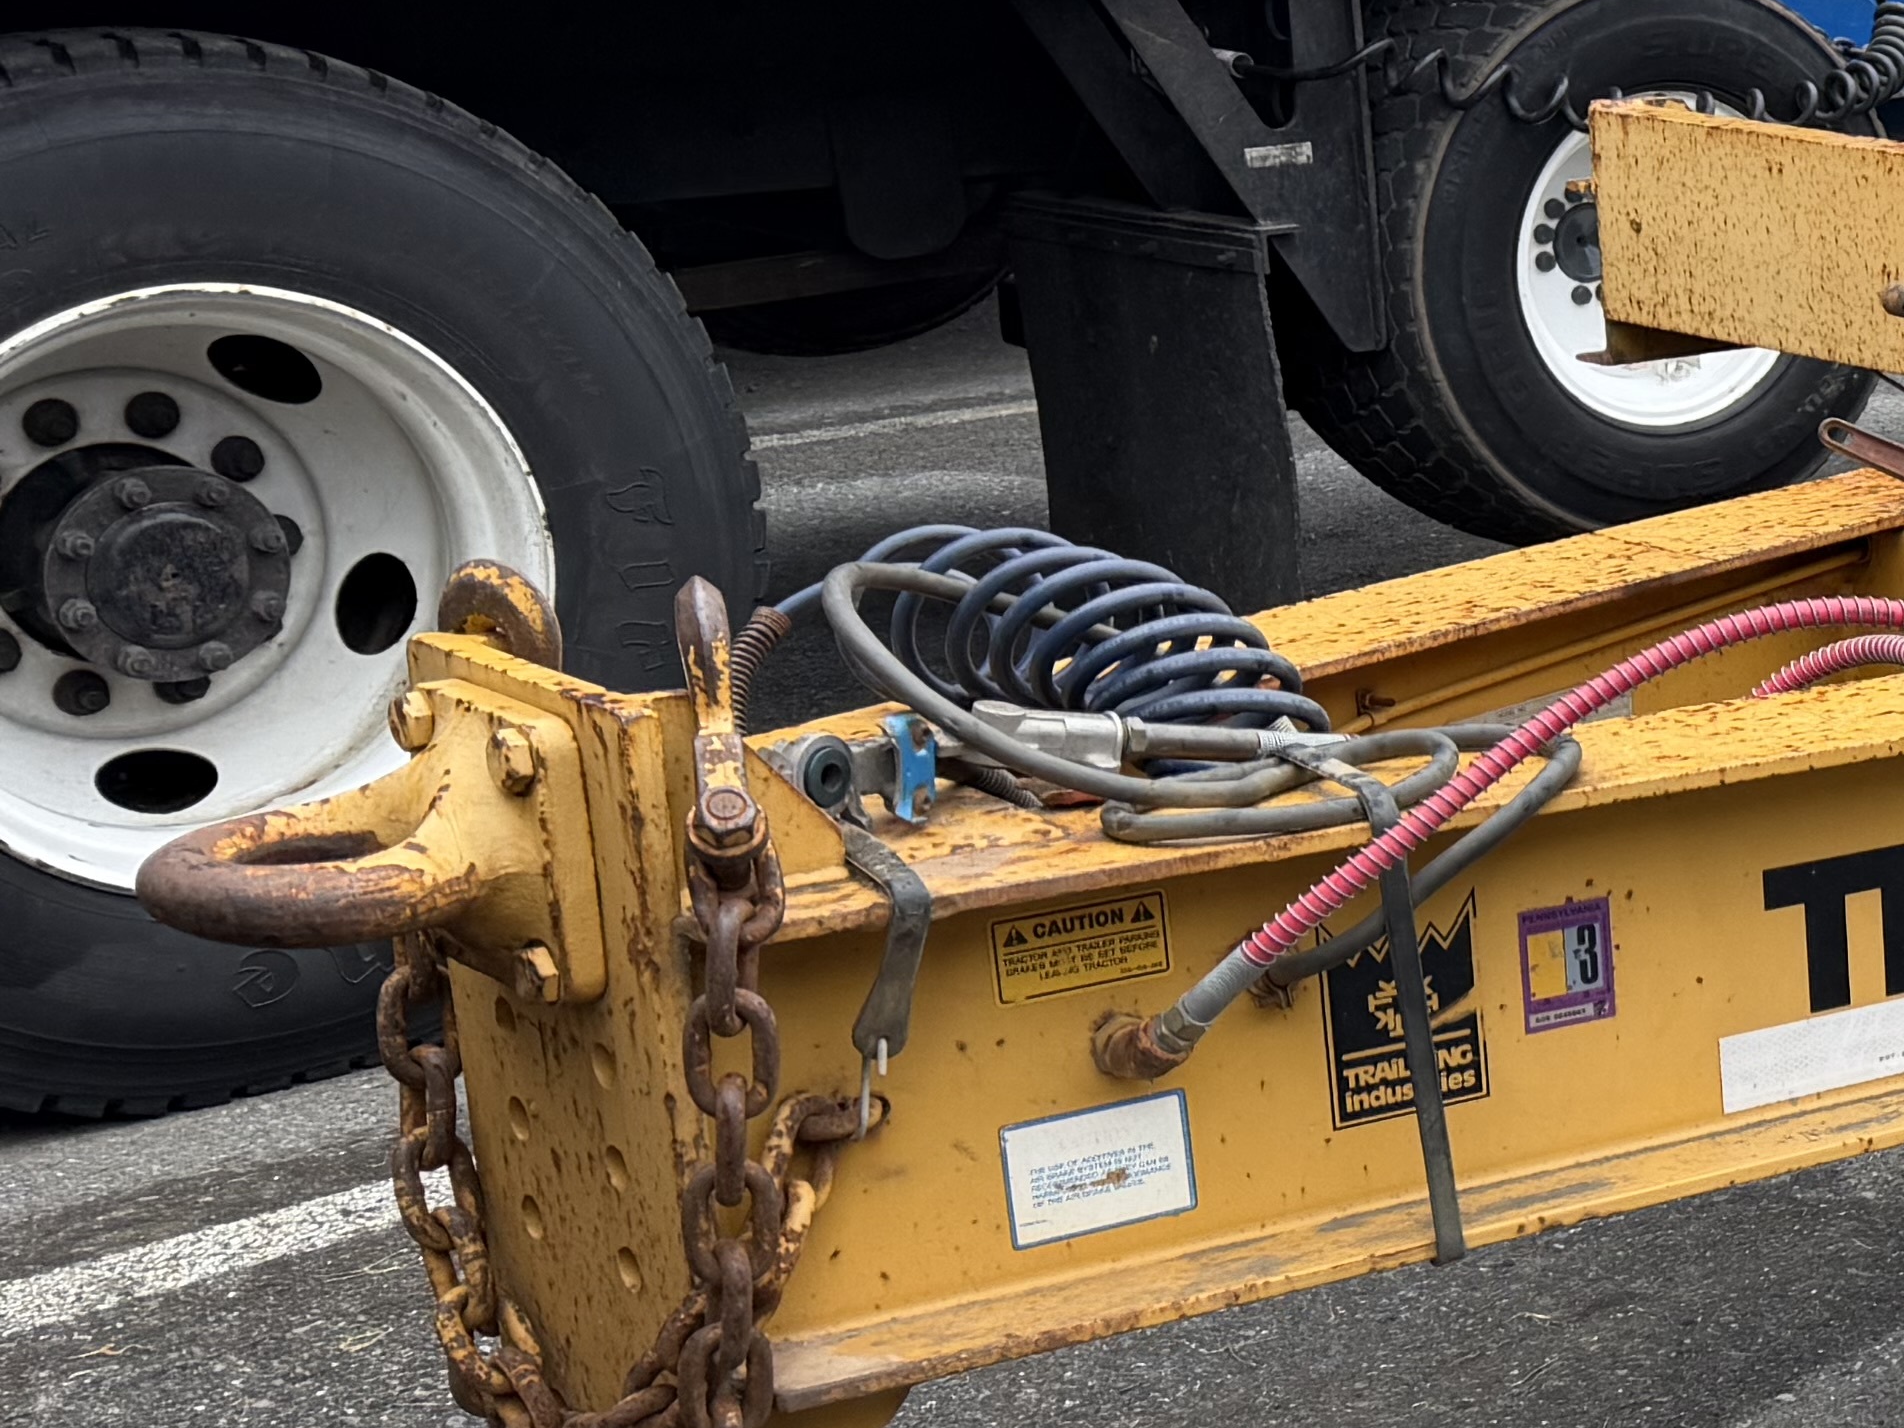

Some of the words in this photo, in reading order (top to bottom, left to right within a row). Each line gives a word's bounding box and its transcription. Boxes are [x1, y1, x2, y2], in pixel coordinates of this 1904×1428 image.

[1032, 908, 1124, 939] CAUTION
[1003, 952, 1047, 967] TRACTOR
[1076, 939, 1115, 954] TRAILER
[1119, 930, 1160, 944] PARKING
[1084, 957, 1128, 972] TRACTOR
[1120, 940, 1158, 955] BEFORE
[1577, 923, 1598, 985] 3
[1345, 1069, 1476, 1113] indusies
